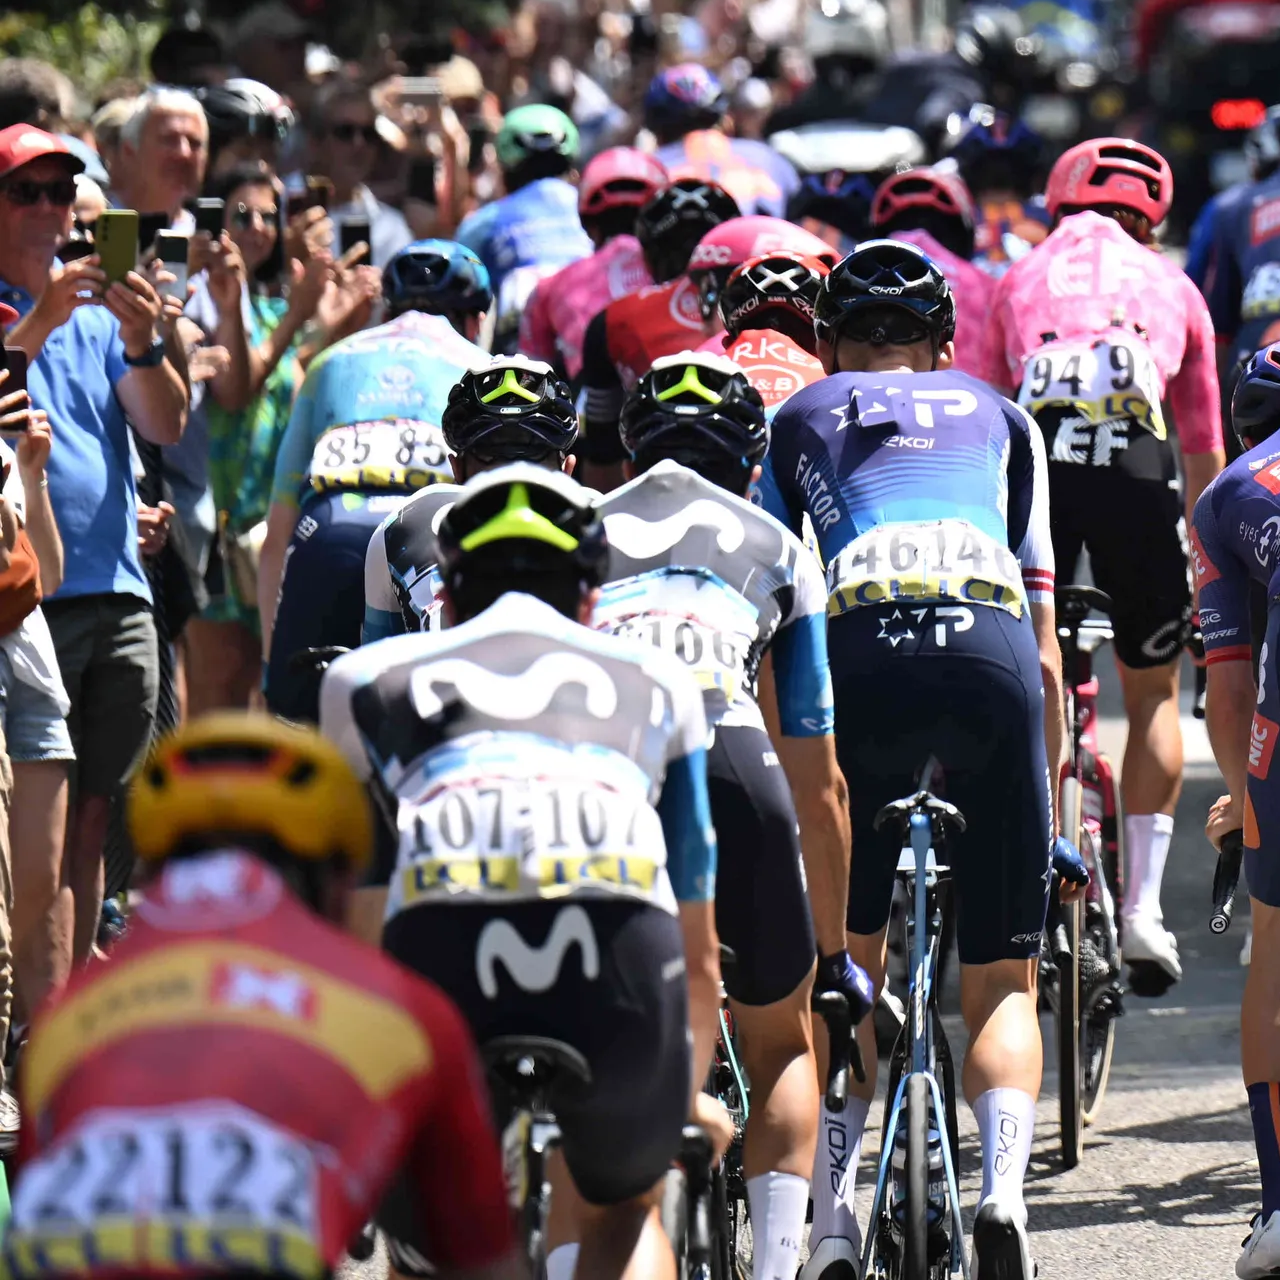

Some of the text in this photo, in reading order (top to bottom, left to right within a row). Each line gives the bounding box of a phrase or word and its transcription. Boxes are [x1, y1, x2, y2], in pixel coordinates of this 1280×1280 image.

[1031, 355, 1083, 398] 94
[324, 427, 371, 468] 85
[395, 427, 447, 466] 85
[795, 453, 841, 532] FACTOR
[411, 787, 504, 857] 107
